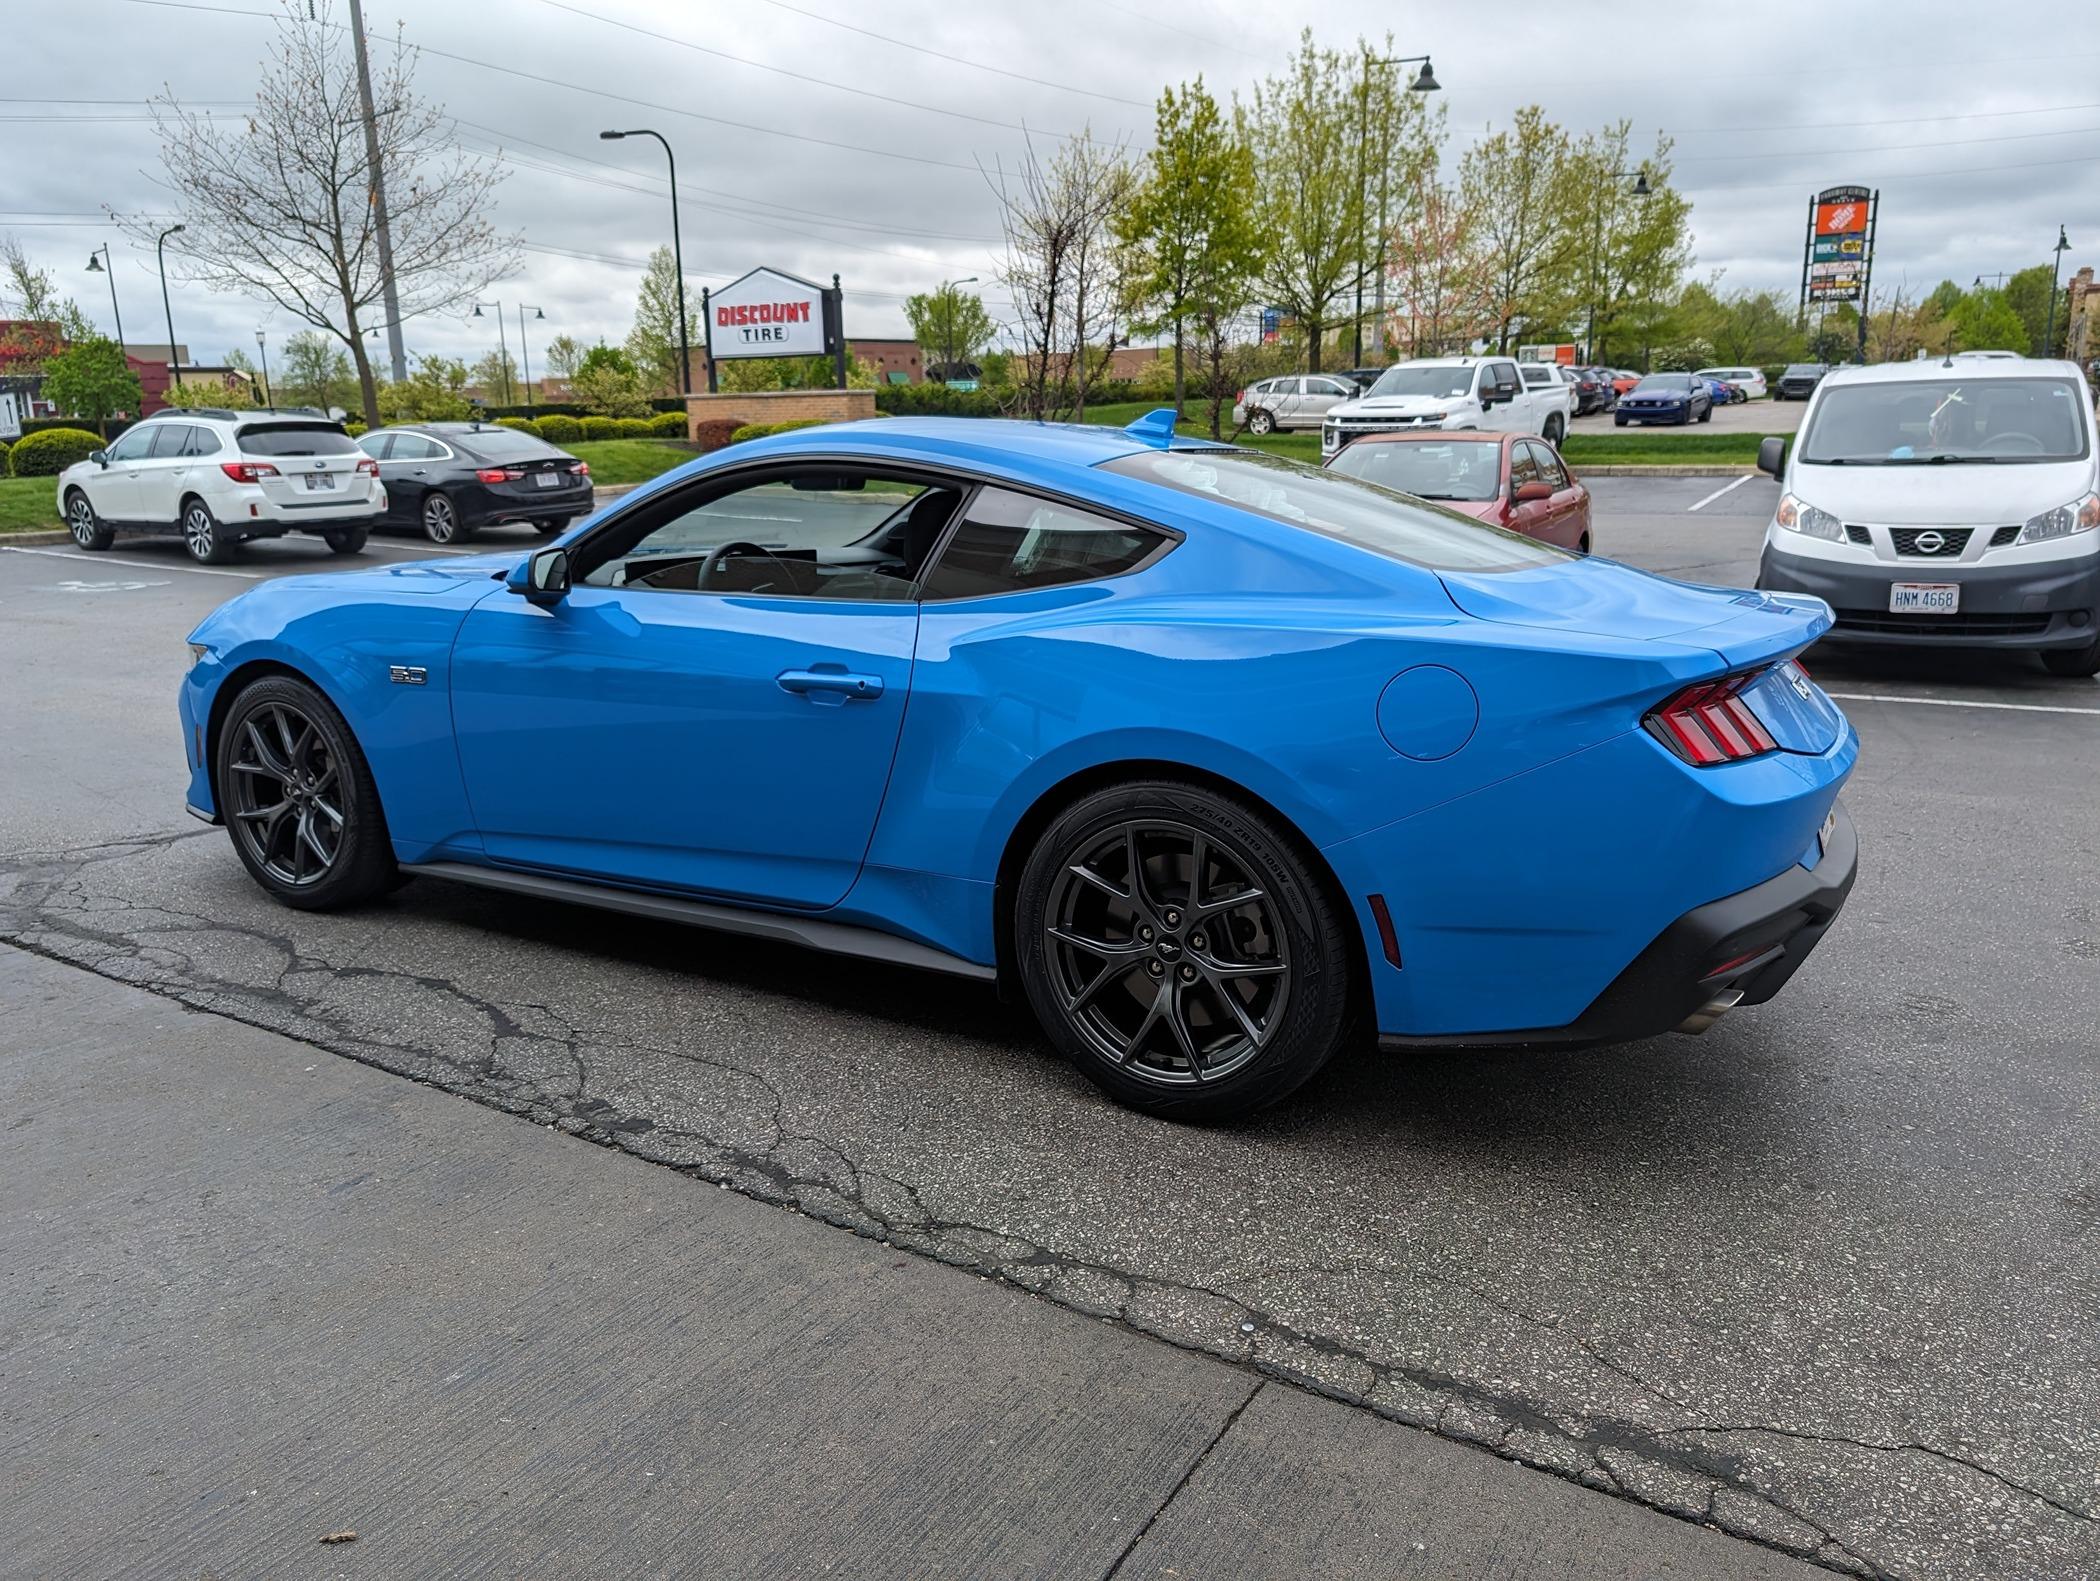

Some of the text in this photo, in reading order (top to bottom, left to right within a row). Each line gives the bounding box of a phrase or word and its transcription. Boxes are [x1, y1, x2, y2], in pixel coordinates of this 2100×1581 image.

[717, 301, 811, 327] DISCOUNT
[742, 327, 783, 342] TIRE
[1896, 592, 1953, 607] HNM 4668
[1190, 803, 1233, 828] 275/40
[1233, 826, 1262, 851] ZR19
